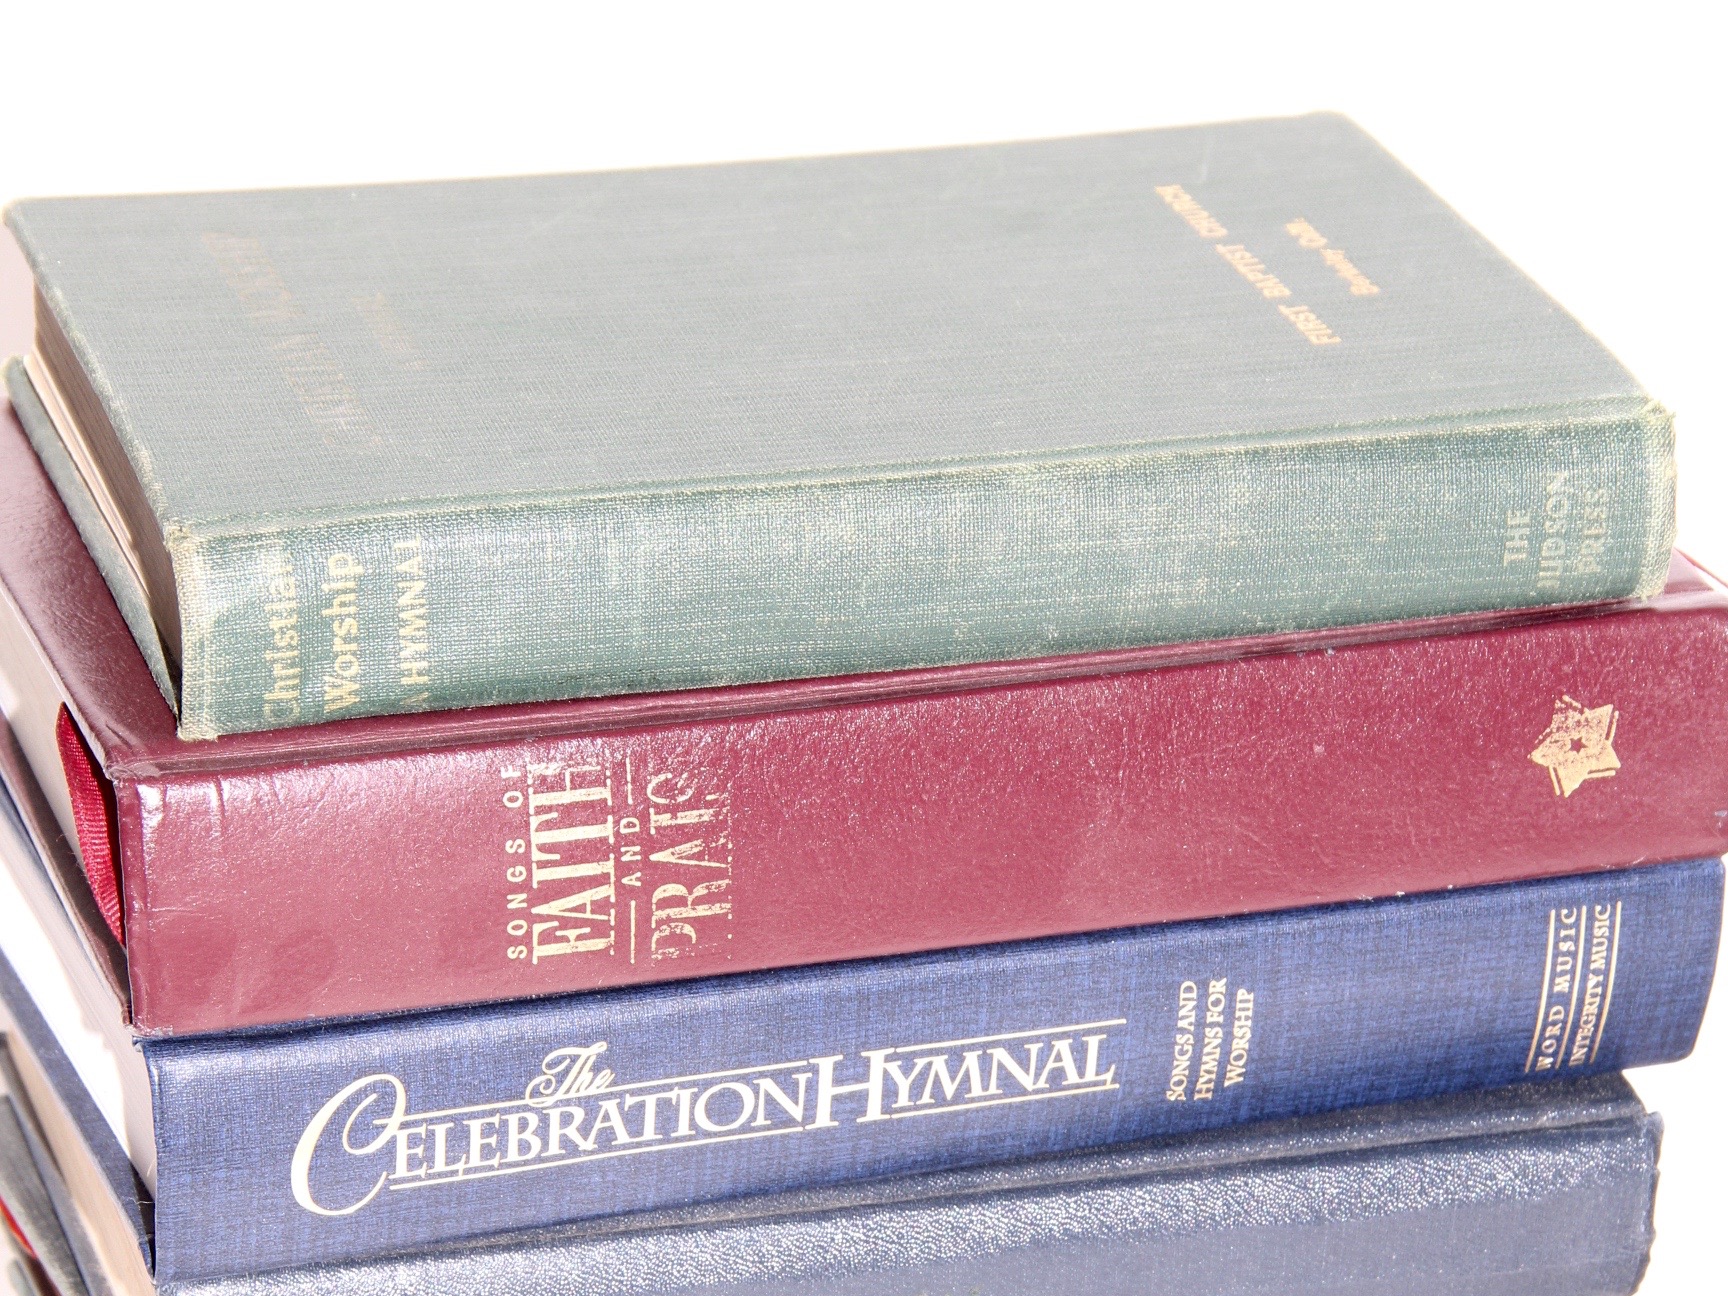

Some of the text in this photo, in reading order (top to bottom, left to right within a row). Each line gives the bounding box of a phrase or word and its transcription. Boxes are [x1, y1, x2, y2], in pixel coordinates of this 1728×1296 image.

[1155, 184, 1342, 346] FIRST BAPTIST CHURCH
[1504, 511, 1531, 566] THE
[1537, 472, 1574, 588] JUDSON
[1577, 488, 1611, 573] PRESS
[320, 553, 365, 714] Worship
[394, 534, 430, 685] HYMNAL
[500, 764, 528, 960] SONGS OF
[526, 760, 615, 964] FAITH
[620, 817, 642, 887] AND
[1166, 981, 1197, 1101] SONGS AND
[1194, 978, 1227, 1100] HYMNS FOR
[1223, 988, 1254, 1087] WORSHIP
[1535, 907, 1577, 1071] WORD MUSIC
[1568, 904, 1611, 1066] INTEGRITY MUSIC
[291, 1034, 1117, 1216] CELEBRATION HYMNAL
[525, 1041, 615, 1107] The
